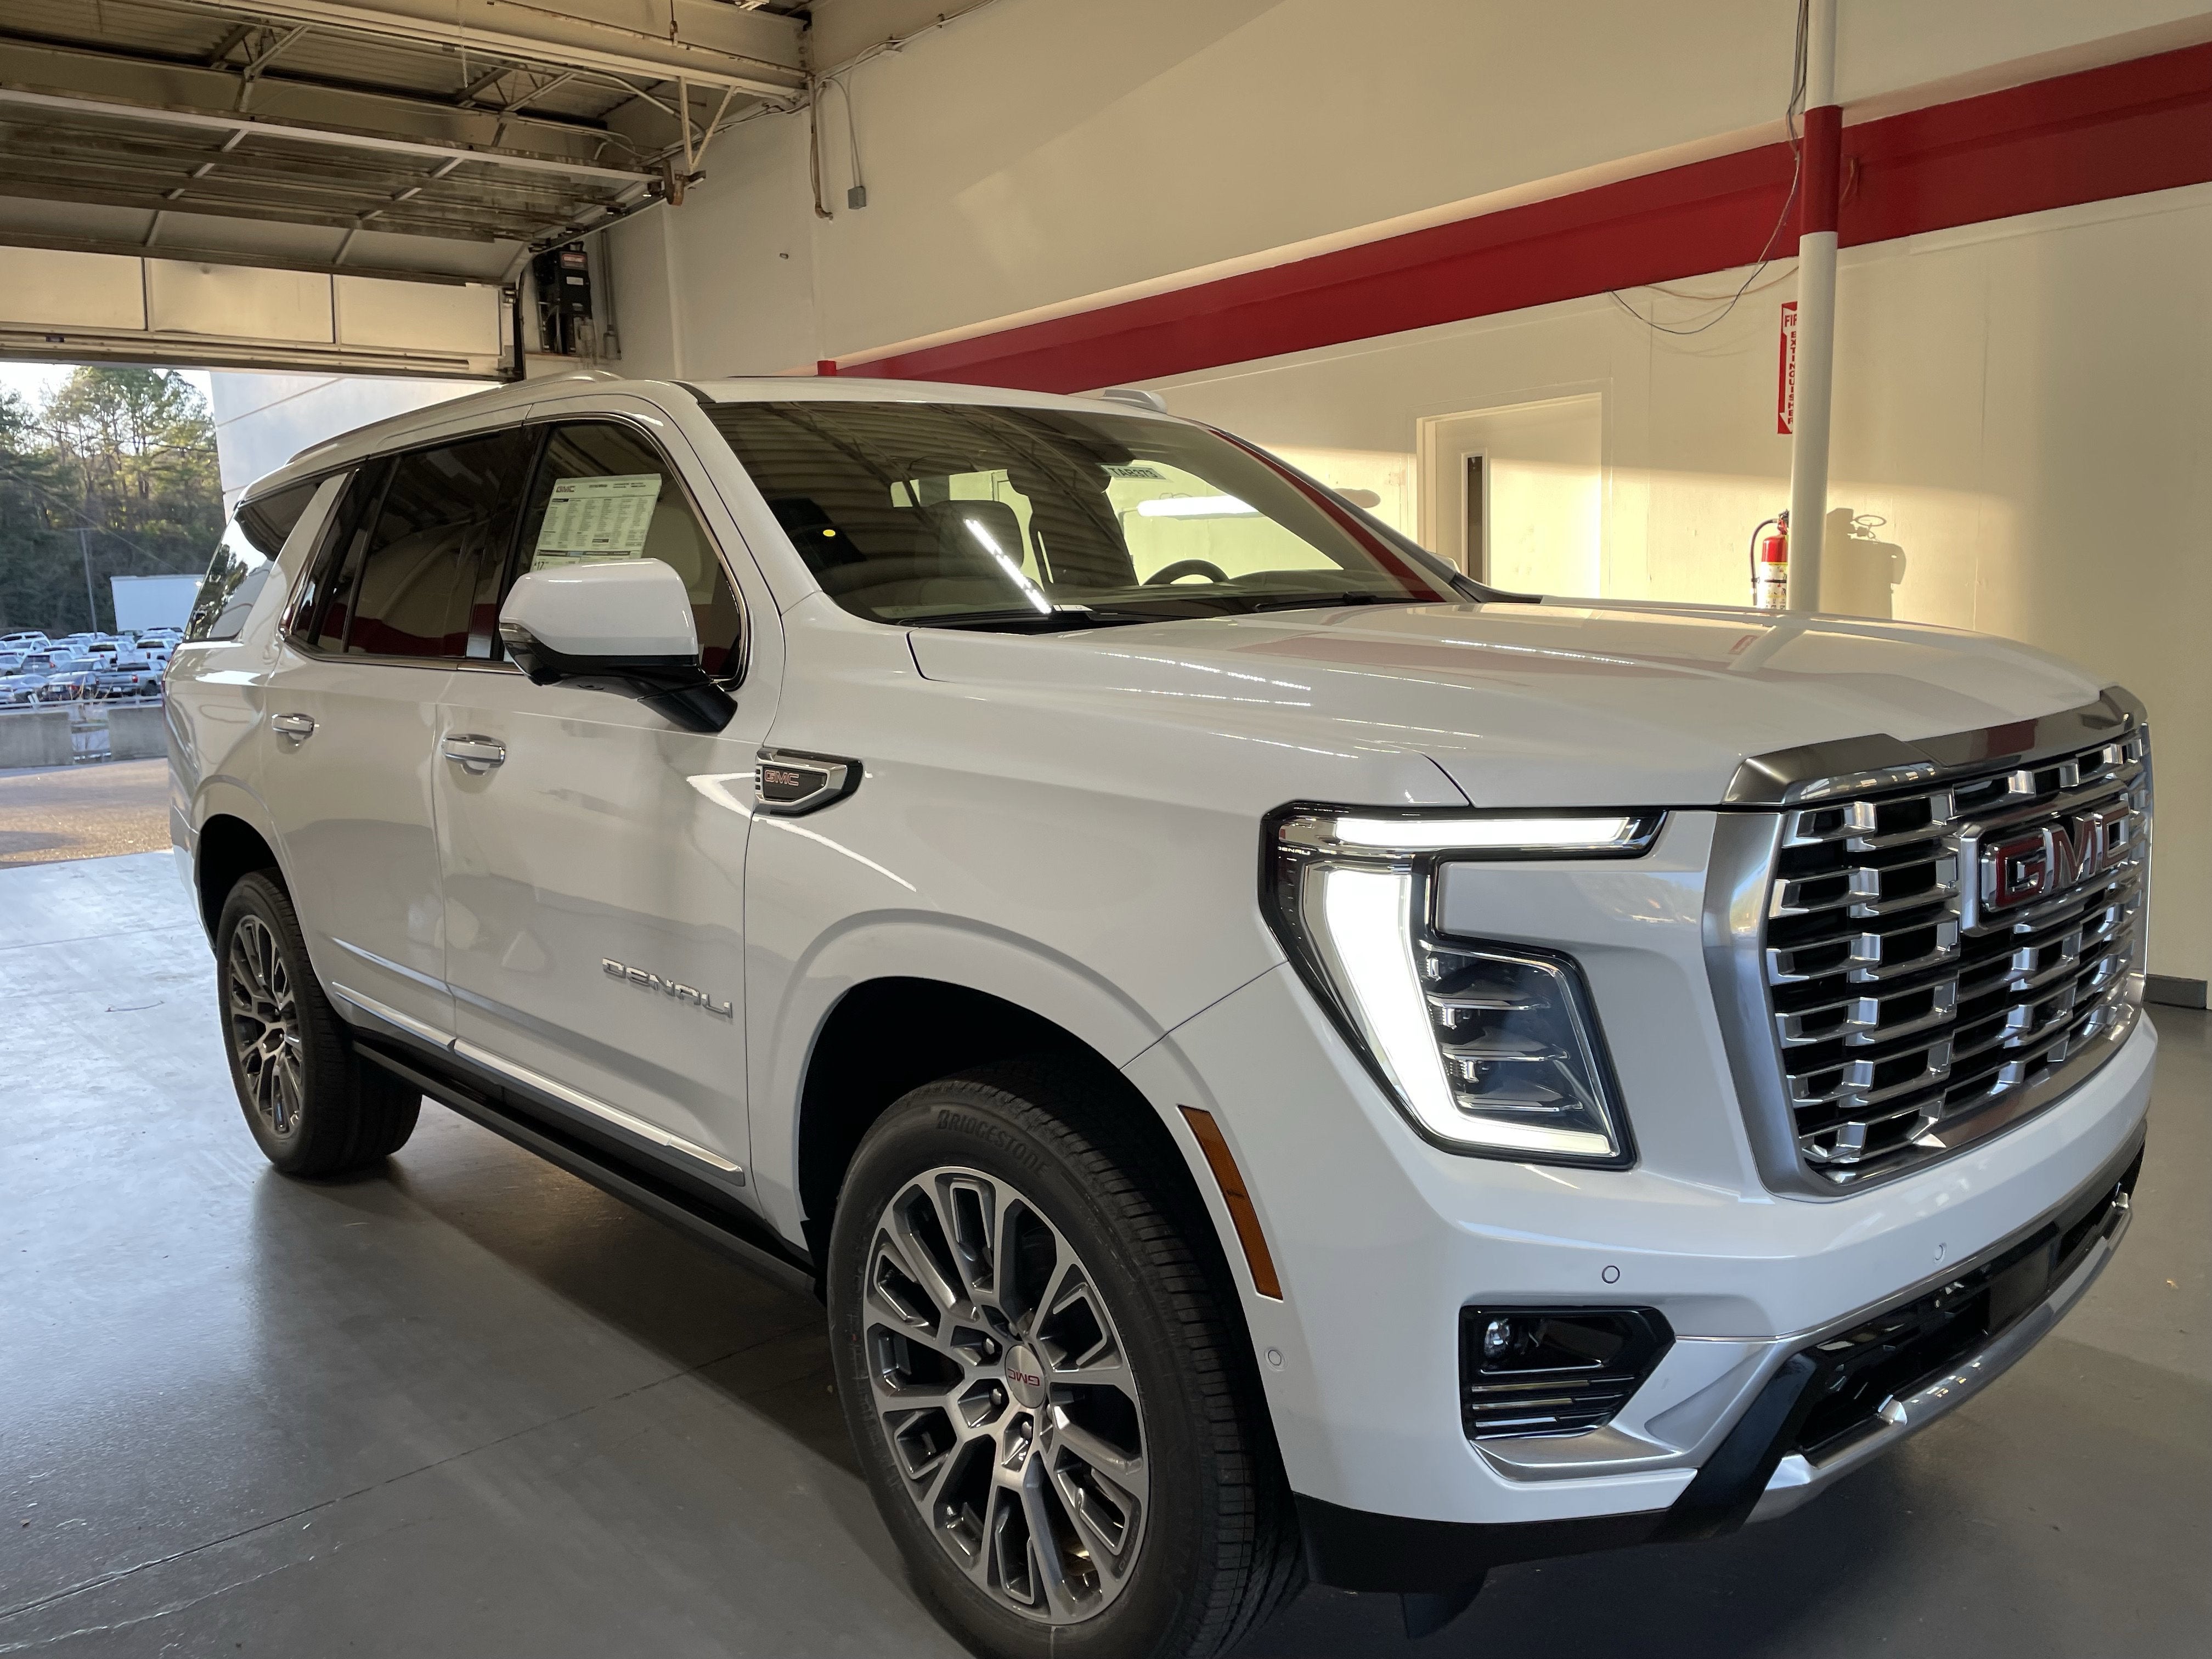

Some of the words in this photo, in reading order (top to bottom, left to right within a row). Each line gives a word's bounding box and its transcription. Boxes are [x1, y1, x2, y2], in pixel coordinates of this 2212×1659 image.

[1784, 314, 1797, 327] FIR
[1787, 331, 1796, 425] EXTINGUISHER
[764, 770, 799, 786] GMC
[1980, 802, 2130, 912] GMC
[602, 957, 733, 1019] DENALI
[935, 1109, 1051, 1176] BRIDGESTONE
[1007, 1368, 1040, 1386] GMC
